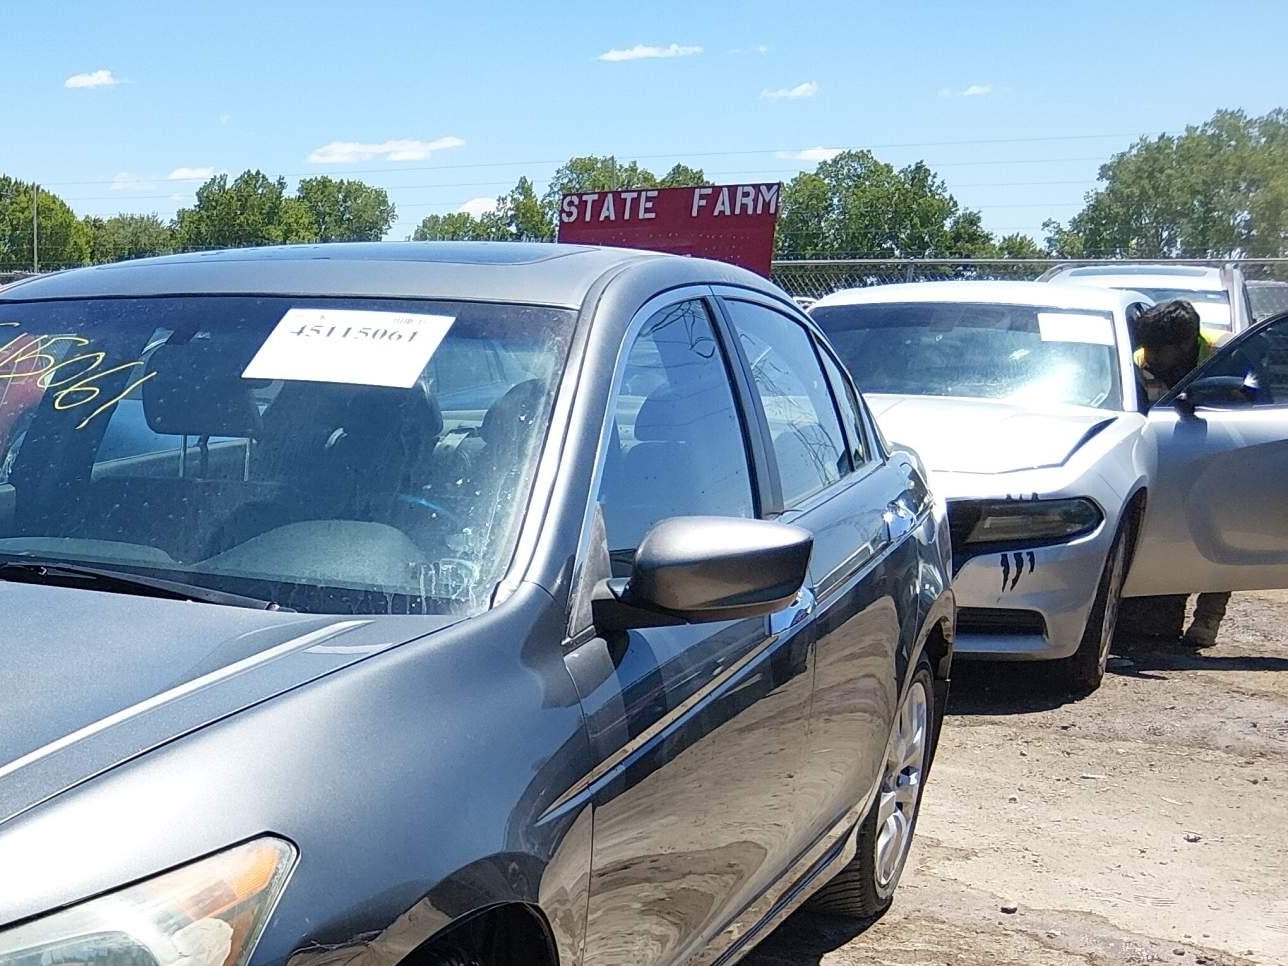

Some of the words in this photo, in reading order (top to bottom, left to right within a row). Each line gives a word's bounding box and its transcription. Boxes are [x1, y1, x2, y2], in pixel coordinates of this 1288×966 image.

[562, 190, 659, 223] STATE
[691, 184, 779, 217] FARM
[290, 324, 419, 343] 45115061
